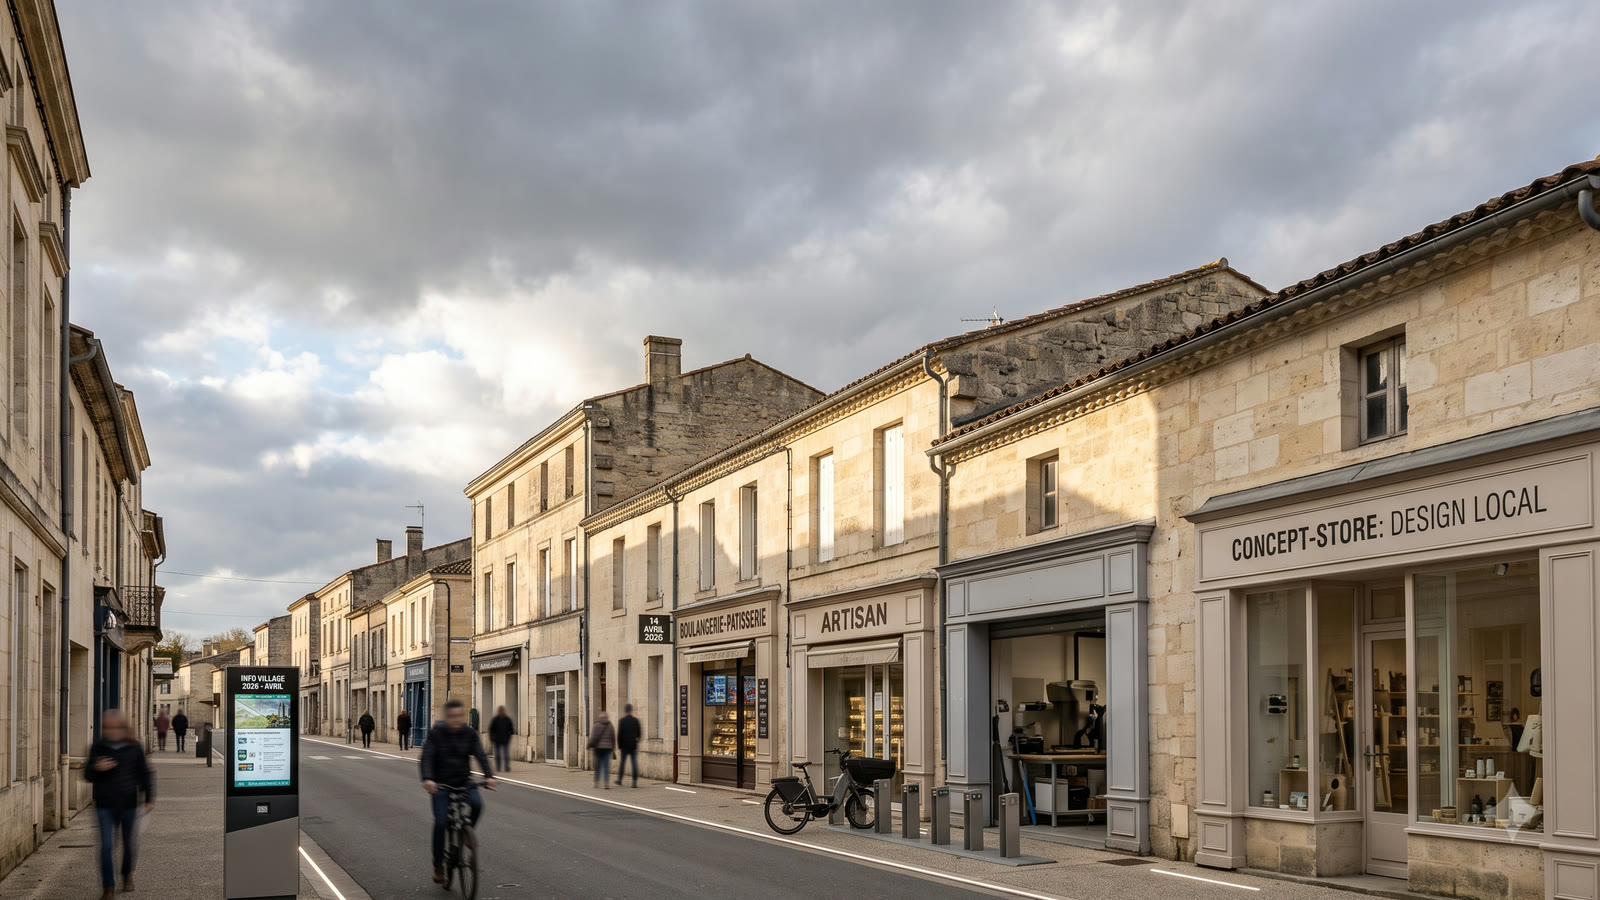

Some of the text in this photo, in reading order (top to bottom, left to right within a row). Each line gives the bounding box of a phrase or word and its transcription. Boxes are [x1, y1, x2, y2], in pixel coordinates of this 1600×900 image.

[1231, 485, 1547, 562] CONCEPT-STORE: DESIGN LOCAL
[649, 617, 659, 625] 14
[680, 607, 767, 639] BOULANGERIE-PATISSERIE
[821, 602, 887, 633] ARTISAN
[644, 633, 664, 641] 2026
[240, 674, 286, 683] INFO VILLAGE
